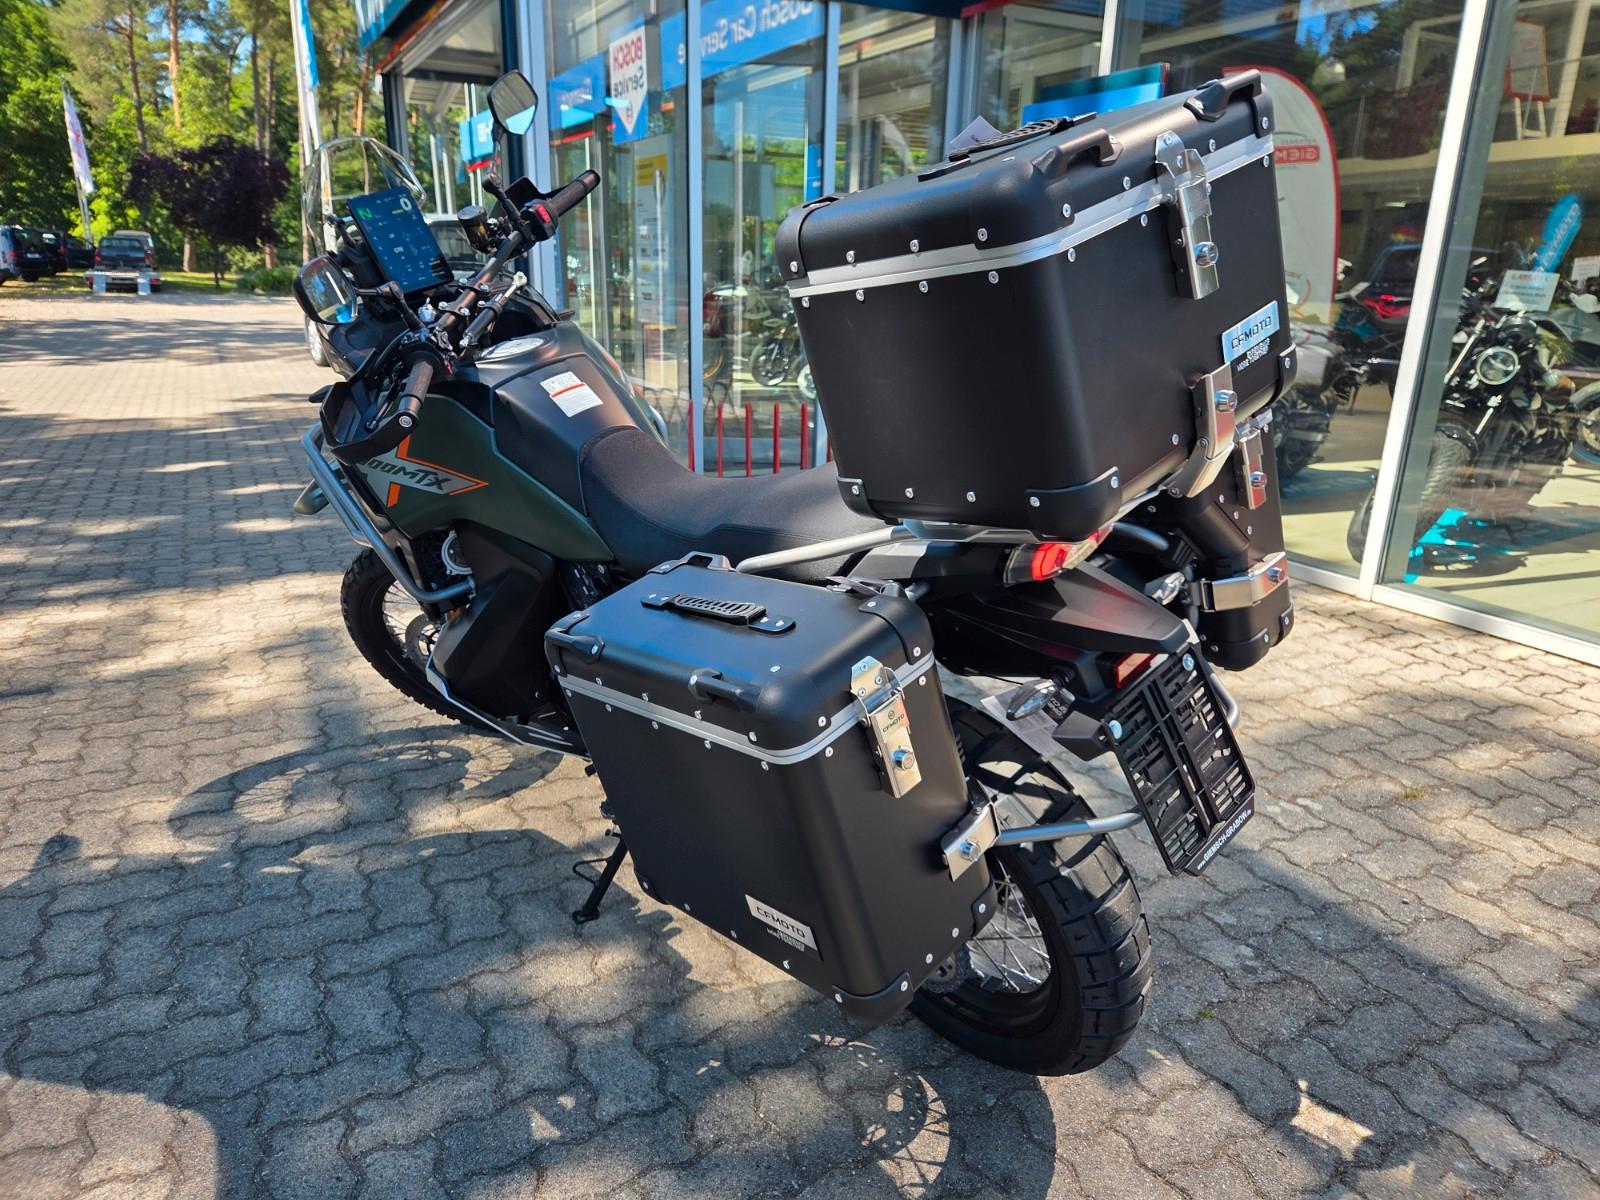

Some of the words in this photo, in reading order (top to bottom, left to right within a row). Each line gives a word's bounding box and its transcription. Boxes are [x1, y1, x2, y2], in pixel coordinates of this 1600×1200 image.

[1231, 316, 1271, 350] CFMOTO
[363, 458, 452, 490] 00MT-X
[882, 713, 905, 733] CFMOTO
[756, 905, 806, 939] CFMOTO
